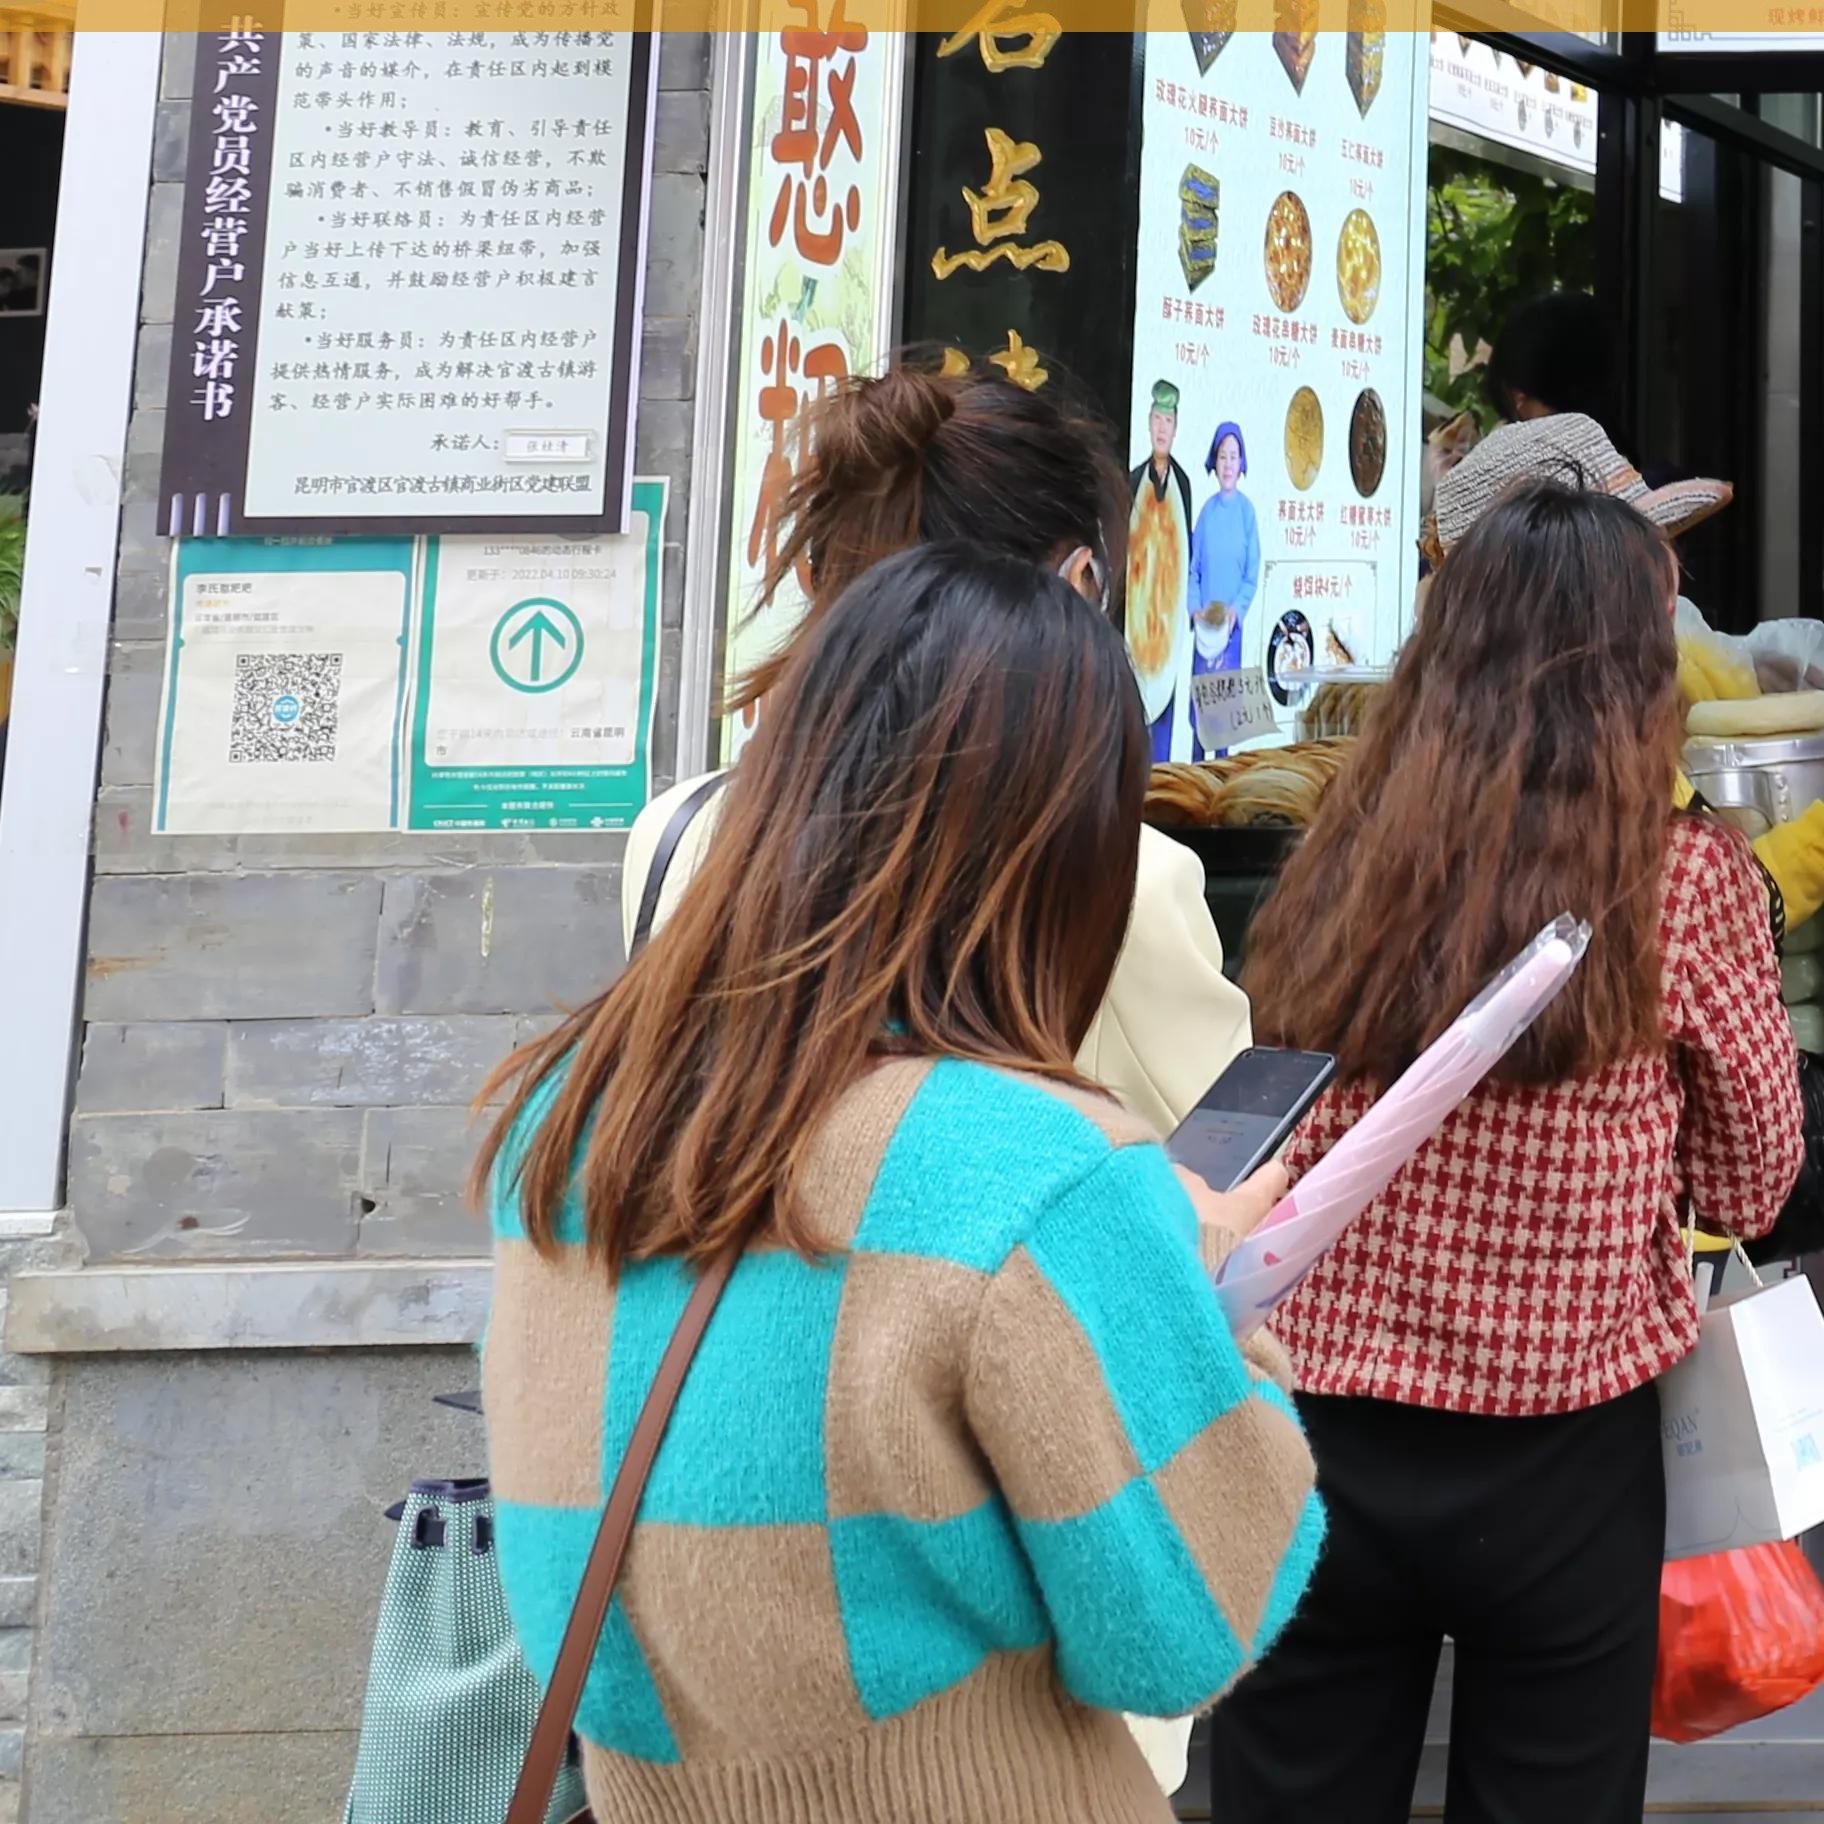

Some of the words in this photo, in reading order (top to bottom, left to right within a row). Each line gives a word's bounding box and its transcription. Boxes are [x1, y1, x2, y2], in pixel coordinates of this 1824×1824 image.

[190, 15, 264, 420] 共产党员经营户承诺书
